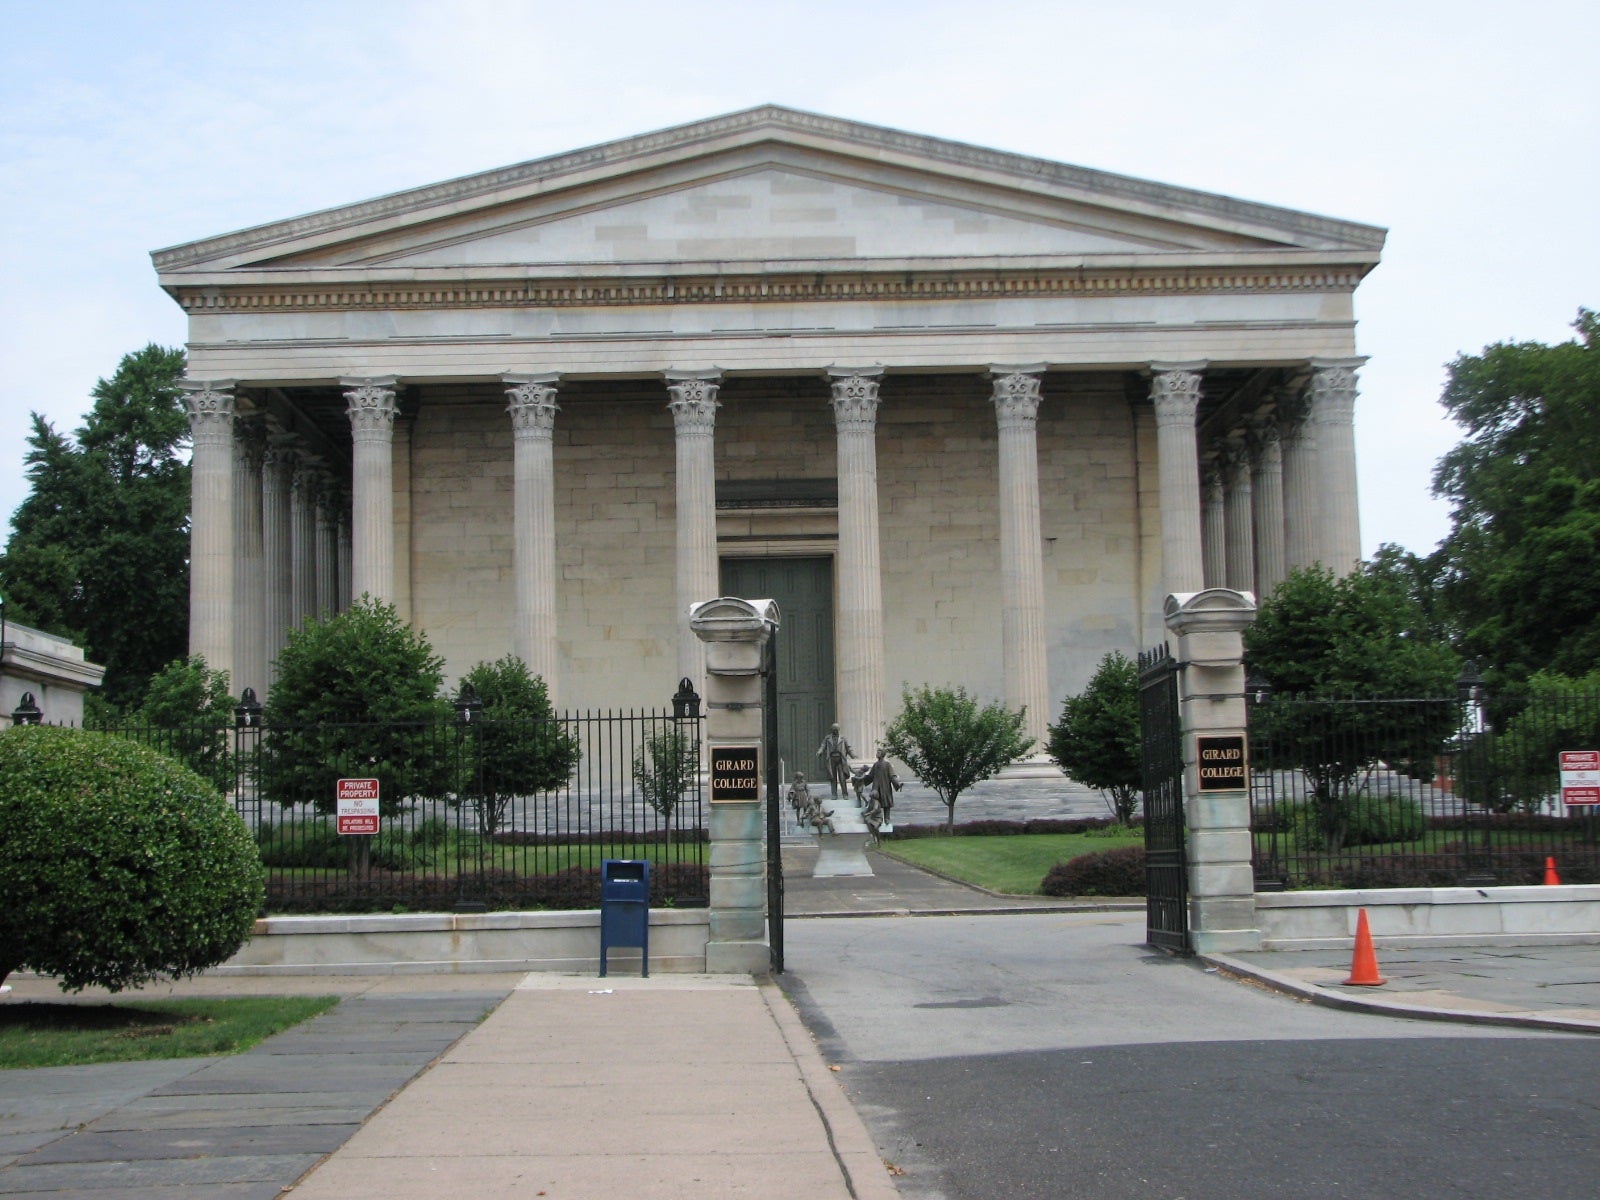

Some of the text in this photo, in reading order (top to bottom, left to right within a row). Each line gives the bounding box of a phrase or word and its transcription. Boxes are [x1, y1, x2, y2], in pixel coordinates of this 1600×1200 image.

[1202, 748, 1240, 760] GIRARD
[715, 759, 754, 771] GIRARD
[1200, 766, 1244, 778] COLLEGE
[344, 781, 372, 790] PRIVATE
[713, 778, 757, 789] COLLEGE
[340, 789, 376, 798] PROPERTY
